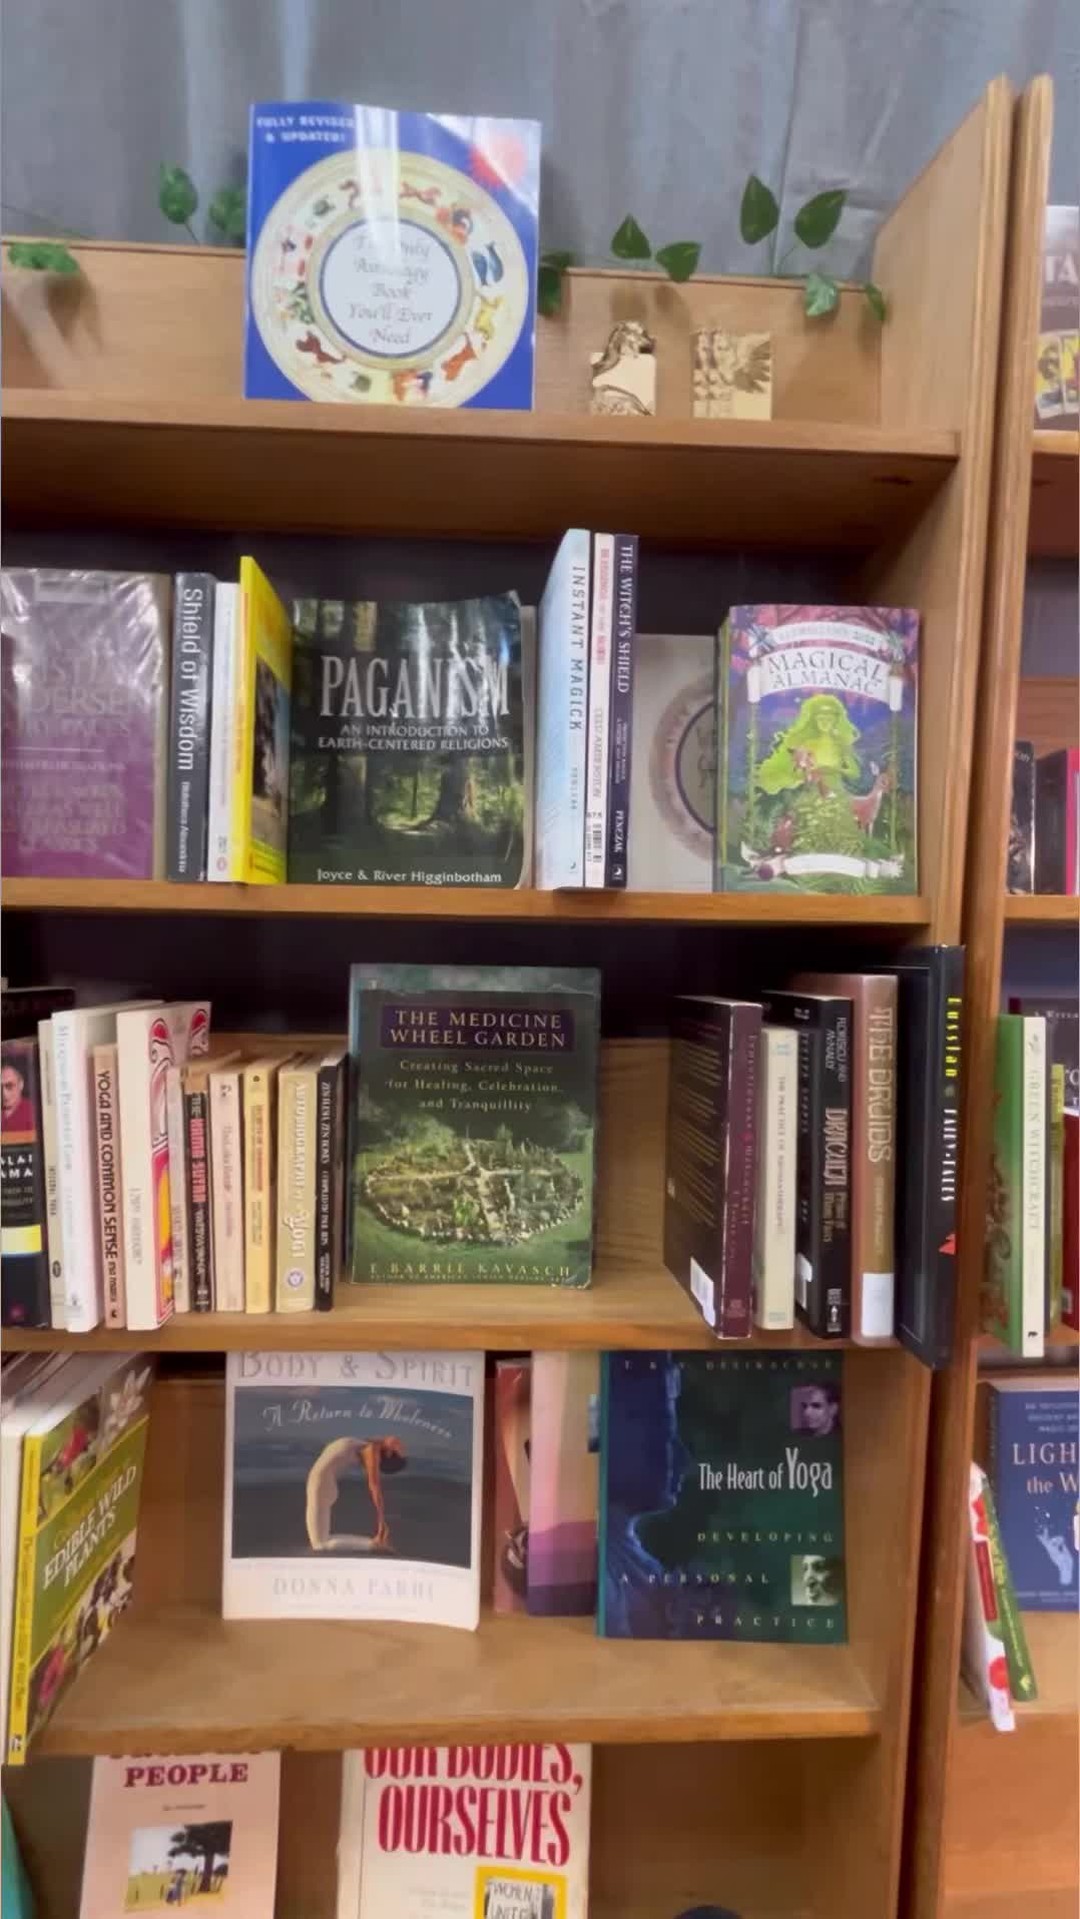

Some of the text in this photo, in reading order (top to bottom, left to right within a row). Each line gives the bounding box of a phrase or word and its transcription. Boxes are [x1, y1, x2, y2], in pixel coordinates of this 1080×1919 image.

[256, 115, 293, 128] FULLY
[370, 326, 410, 344] Need
[617, 544, 634, 693] THE WITCH'S SHIELD
[569, 566, 586, 730] INSTANT MAGICK
[178, 588, 203, 770] Shield of Wisdom
[768, 650, 883, 684] MAGICAL
[320, 655, 510, 719] PAGANISM
[772, 669, 880, 695] ALMANAC
[318, 736, 509, 750] EARTH-CENTERED RELIGIONS
[340, 723, 490, 738] AN INTRODUCTION TO
[317, 869, 502, 886] Joyce & River Higginbotham
[395, 1010, 562, 1029] THE MEDICINE
[390, 1028, 566, 1048] WHEEL GARDEN
[399, 1060, 554, 1075] Creating Sacred Space
[321, 1081, 331, 1096] ZEN
[388, 1078, 409, 1090] for
[414, 1078, 472, 1093] Healing,
[867, 1006, 893, 1163] THE DRUIDS
[1028, 1070, 1042, 1122] GREEN
[191, 1095, 202, 1115] THE
[419, 1098, 532, 1113] and Tranquillity
[190, 1118, 205, 1158] KAMA
[321, 1123, 331, 1138] ZEN
[823, 1107, 848, 1186] DRACULA
[97, 1070, 118, 1259] YOGA AND COMMON SENSE
[192, 1160, 207, 1203] SUTRA
[1028, 1129, 1042, 1231] WITCHCRAFT
[391, 1262, 465, 1274] BARRIE
[478, 1264, 569, 1276] KAVASCH
[238, 1351, 473, 1387] BODY & SPIRIT
[263, 1396, 452, 1439] A Return to Wholeness
[1012, 1442, 1077, 1466] LIGH
[699, 1447, 833, 1497] The Heart of Yoga
[1026, 1476, 1054, 1494] the
[43, 1508, 96, 1590] EDIBLE
[99, 1464, 137, 1517] WILD
[697, 1532, 833, 1543] DEVELOPING
[64, 1504, 116, 1587] PLANTS
[273, 1577, 355, 1597] DONNA
[622, 1573, 770, 1584] A PERSONAL
[697, 1615, 834, 1629] PRACTICE
[124, 1762, 249, 1788] PEOPLE
[448, 1743, 583, 1793] BODIES,
[377, 1784, 572, 1867] OURSELVES
